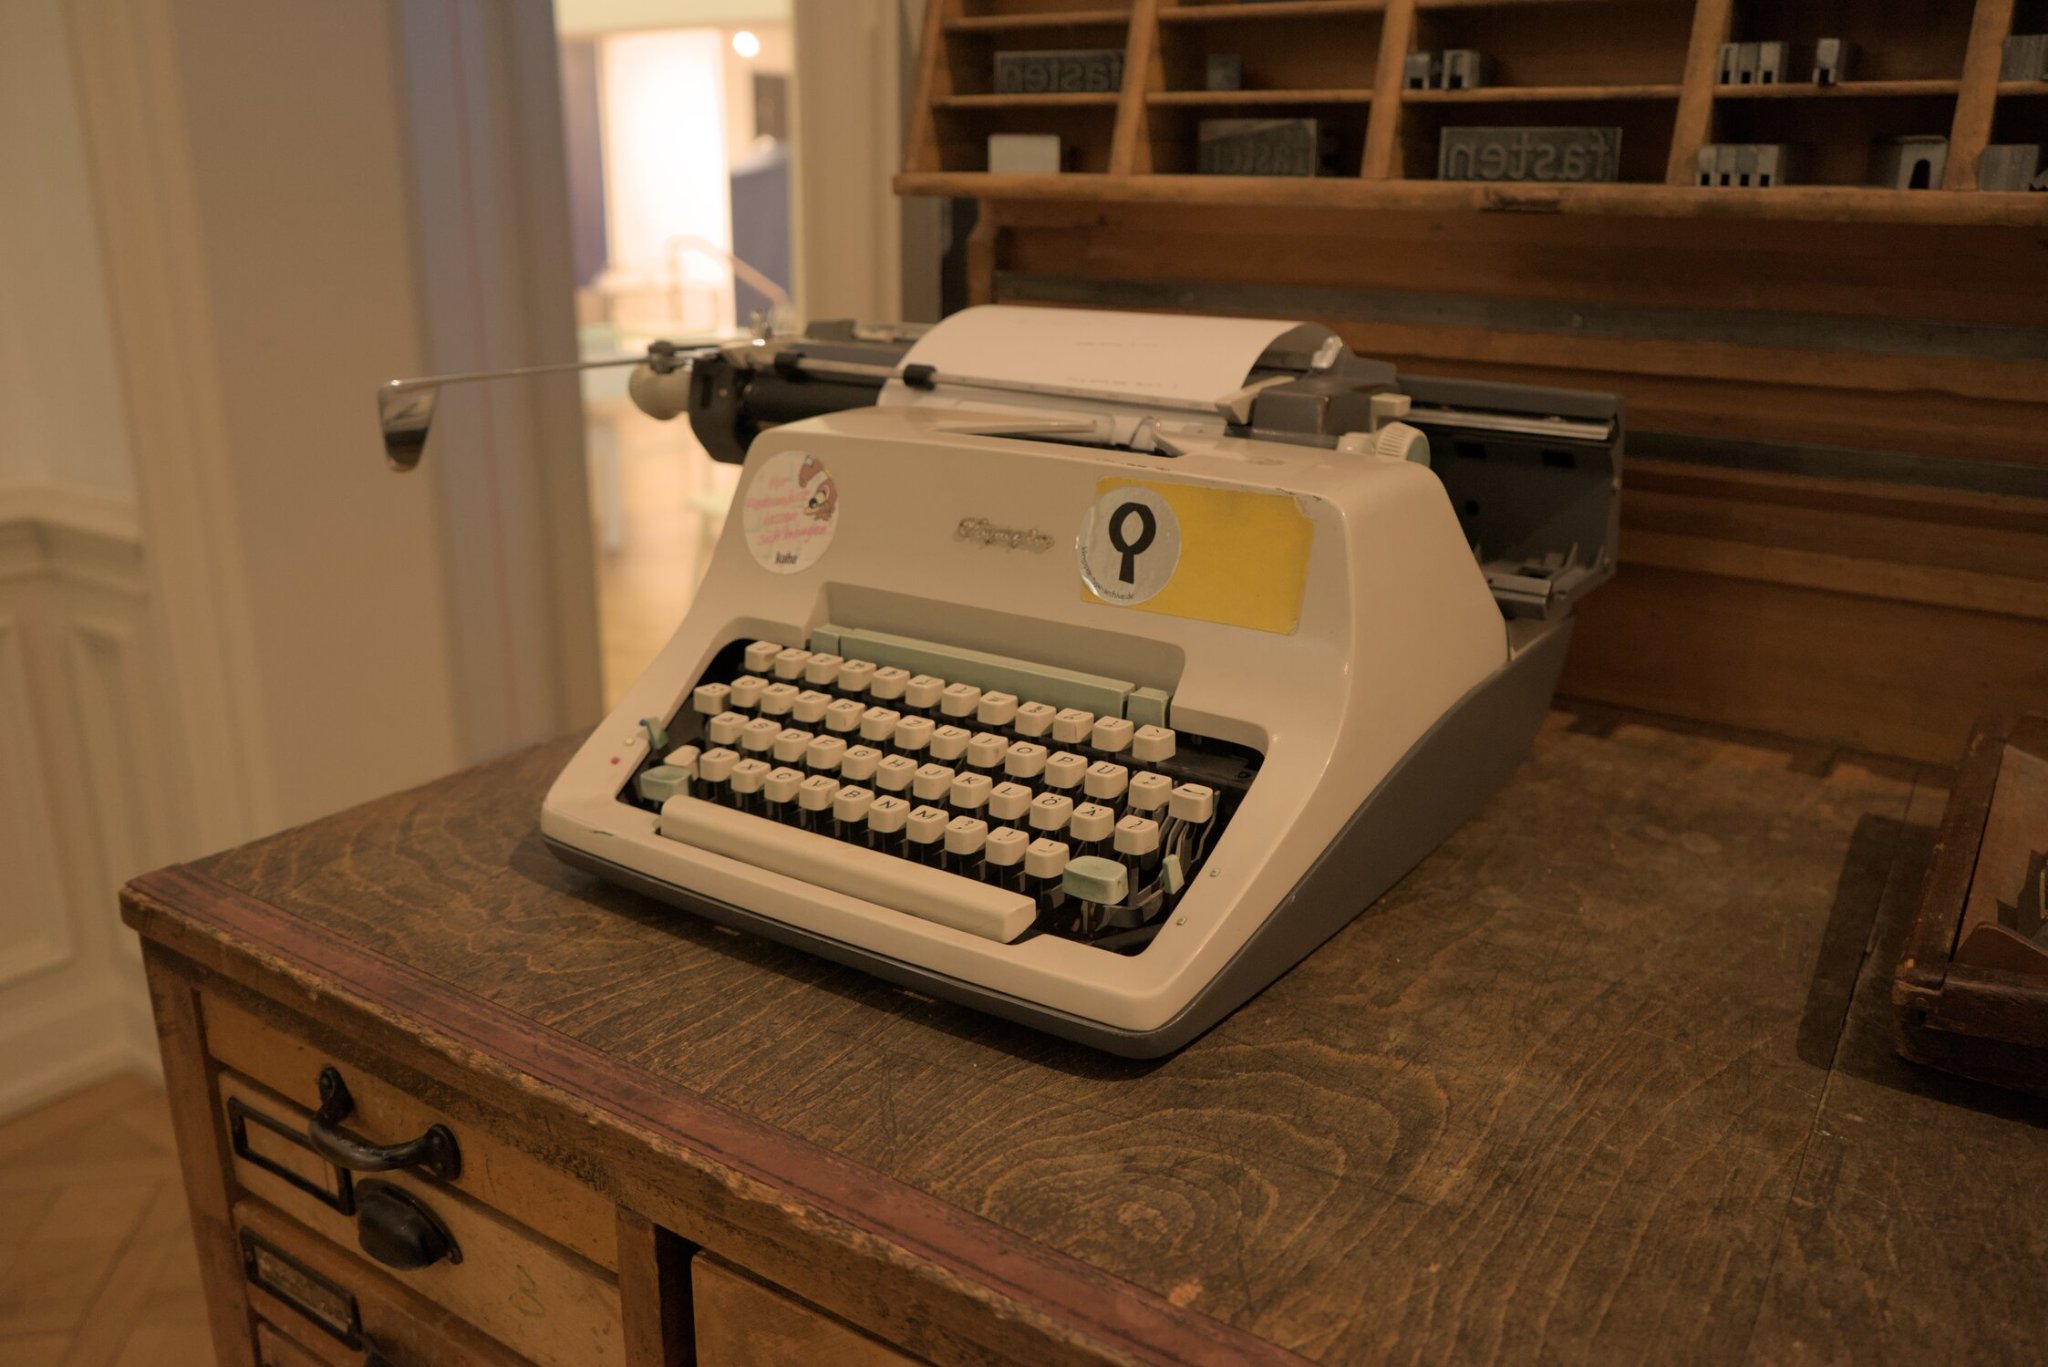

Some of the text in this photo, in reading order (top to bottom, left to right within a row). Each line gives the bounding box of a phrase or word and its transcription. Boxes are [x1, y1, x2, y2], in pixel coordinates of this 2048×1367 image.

[1097, 764, 1116, 775] Ü
[1042, 796, 1062, 807] Ö
[1081, 806, 1103, 817] Ä
[914, 810, 937, 820] M
